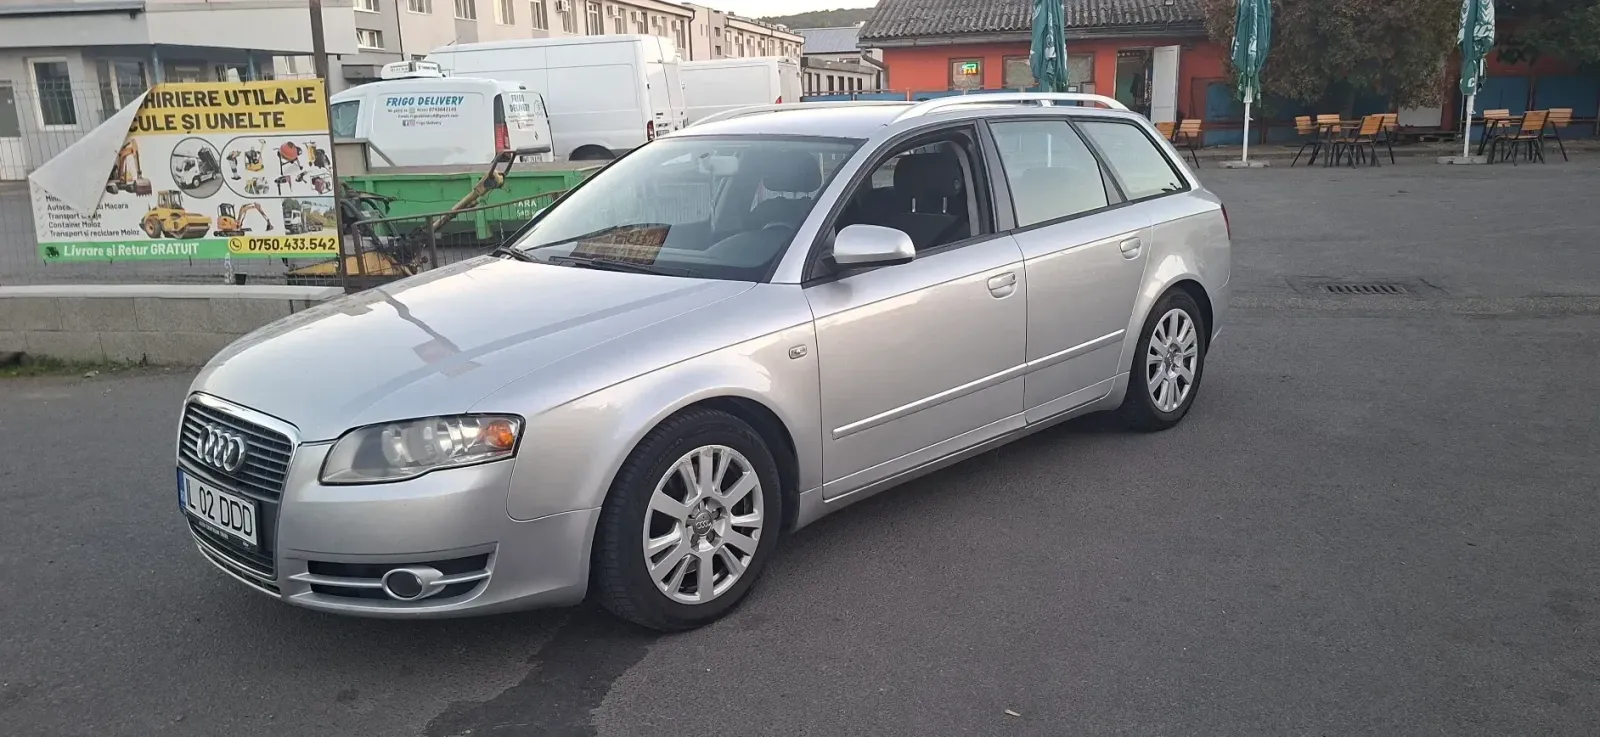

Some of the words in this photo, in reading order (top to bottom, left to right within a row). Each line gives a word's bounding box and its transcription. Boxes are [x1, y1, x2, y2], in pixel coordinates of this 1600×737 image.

[139, 90, 221, 109] HIRIERE
[225, 87, 316, 107] UTILAJE
[386, 96, 415, 106] FRIGO
[418, 95, 464, 106] DELIVERY
[206, 111, 285, 130] UNELTE
[48, 212, 79, 221] Transport
[48, 220, 80, 229] Container
[82, 220, 101, 229] Moloz
[50, 230, 83, 239] Transport
[90, 229, 119, 237] reciclare
[121, 228, 140, 237] Moloz
[63, 244, 104, 257] Livrare
[118, 244, 148, 256] Retur
[150, 242, 199, 255] GRATUIT
[248, 238, 336, 251] 0750.433.542
[199, 486, 215, 520] 02
[220, 495, 253, 537] DDD
